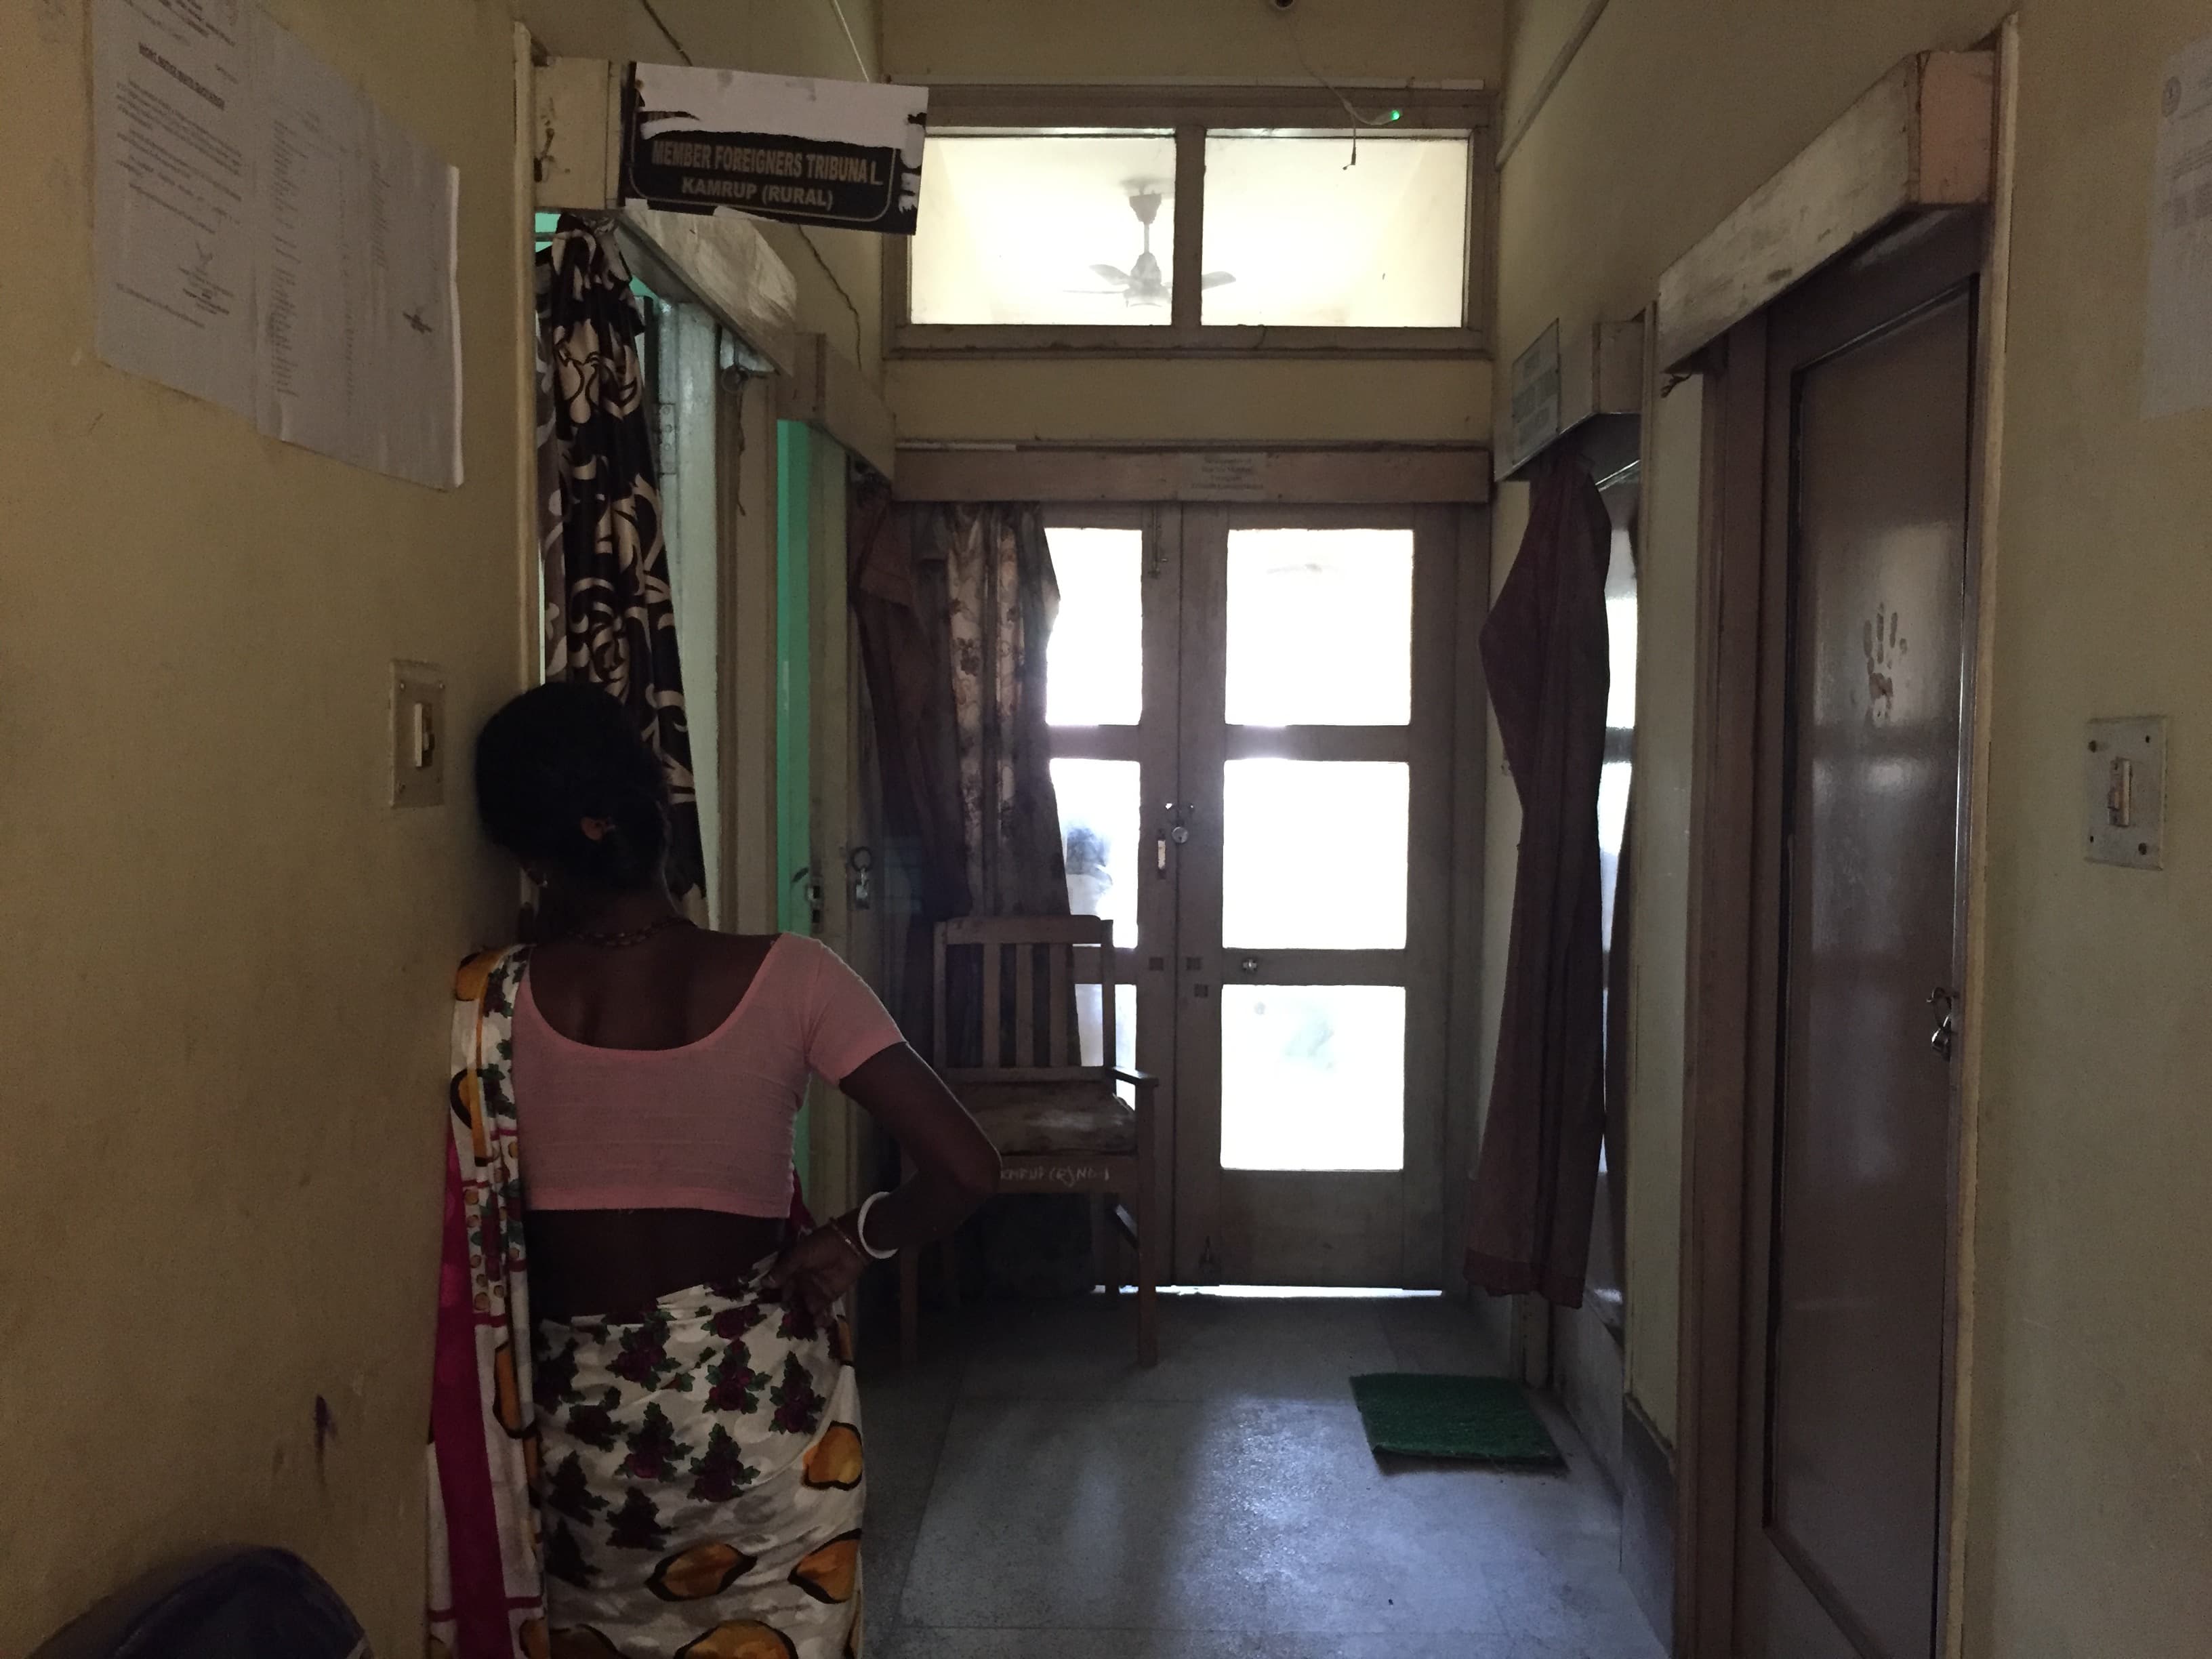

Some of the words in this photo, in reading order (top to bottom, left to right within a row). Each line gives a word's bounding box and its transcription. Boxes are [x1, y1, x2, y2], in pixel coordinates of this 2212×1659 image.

[651, 140, 711, 168] MEMBER
[714, 145, 802, 178] FOREIGNERS
[682, 178, 758, 202] KAMRUP
[762, 184, 834, 211] (RURAL)
